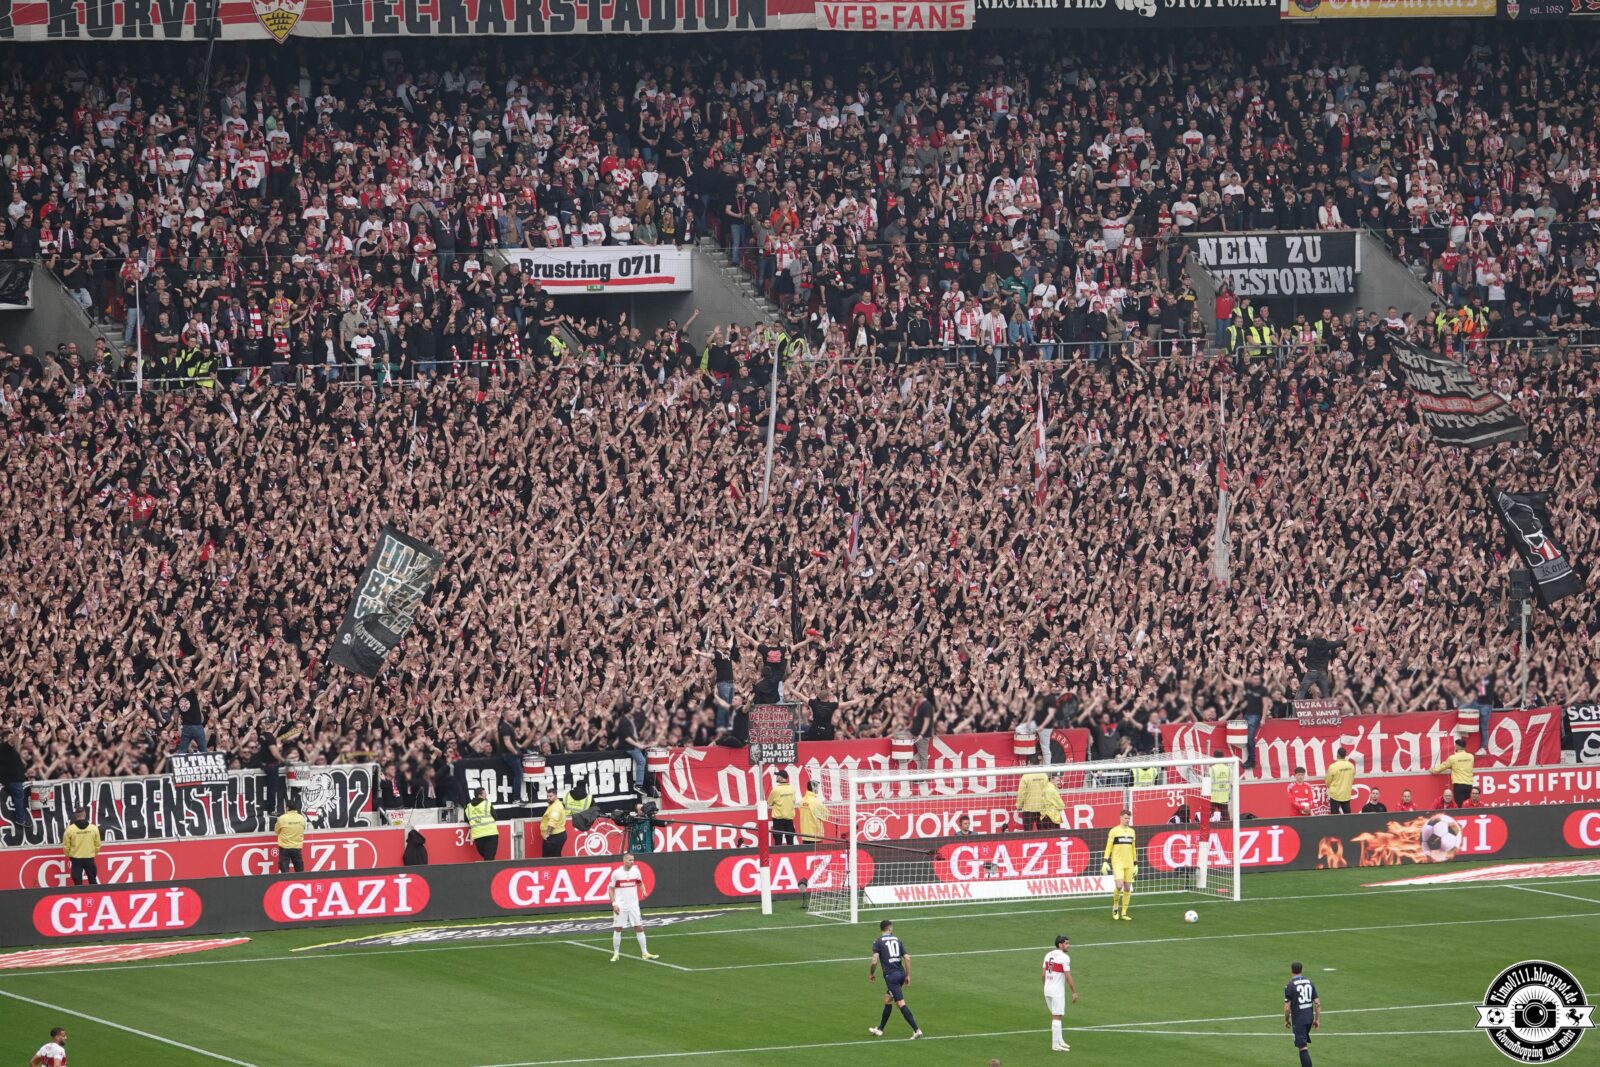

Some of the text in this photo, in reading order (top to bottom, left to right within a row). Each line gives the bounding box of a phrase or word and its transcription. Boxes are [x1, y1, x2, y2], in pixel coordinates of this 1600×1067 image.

[332, 0, 767, 36] NECKARSTADION
[823, 5, 966, 29] VFB-FANS
[1198, 235, 1322, 266] NEIN ZU
[520, 254, 661, 282] Brustring 0711
[1488, 712, 1552, 768] 97
[172, 754, 225, 769] ULTRAS
[174, 765, 226, 776] BEDEUTET
[175, 772, 229, 784] WIDERSTAND
[328, 768, 371, 830] 02
[1167, 790, 1185, 807] 35
[894, 883, 973, 902] WINAMAX
[1026, 877, 1105, 896] WINAMAX
[885, 940, 900, 958] 10
[1296, 984, 1312, 1004] 30
